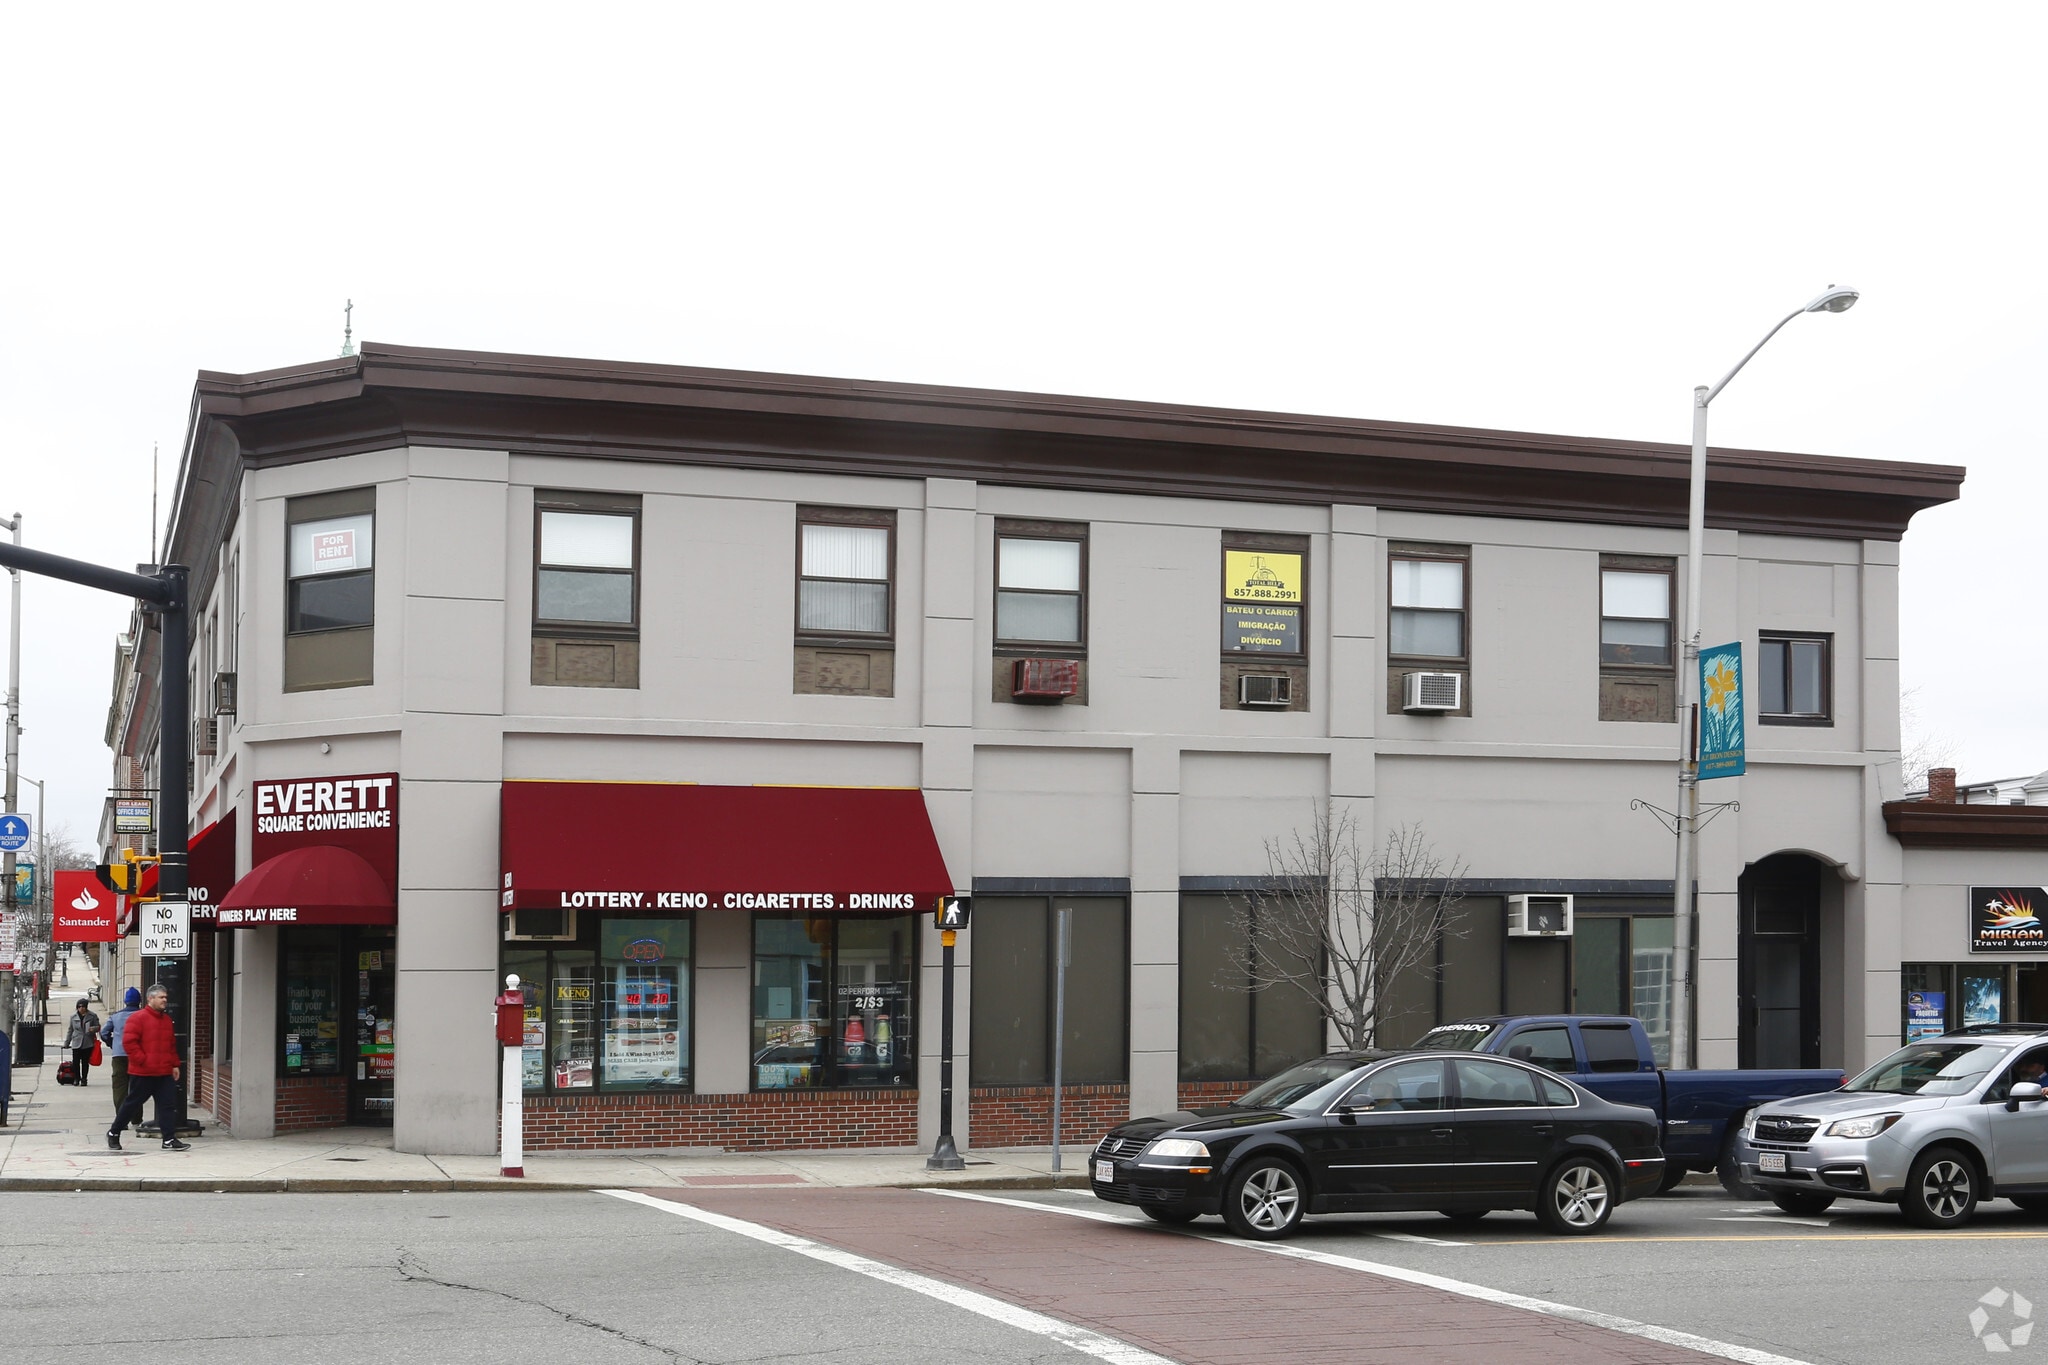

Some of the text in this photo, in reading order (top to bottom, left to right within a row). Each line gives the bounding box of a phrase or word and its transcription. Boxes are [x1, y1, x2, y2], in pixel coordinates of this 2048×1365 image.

[322, 535, 344, 546] FOR
[318, 545, 348, 559] RENT
[1233, 588, 1297, 599] 857.888.2991
[1226, 606, 1298, 617] BATEU O CARRO?
[1238, 621, 1286, 632] IMIGRAÇÃO
[257, 778, 392, 814] EVERETT
[134, 808, 149, 816] SPACE
[258, 810, 391, 834] SQUARE CONVENIENCE
[561, 891, 915, 909] LOTTERY KENO CIGARETTES DRINKS
[156, 908, 173, 919] NO
[245, 908, 267, 922] PLAY
[269, 907, 297, 921] HERE
[58, 916, 111, 927] Santander
[152, 923, 178, 934] TURN
[1980, 929, 2044, 940] MIRIAM
[144, 938, 184, 949] ON RED
[2012, 939, 2048, 948] Agency
[623, 943, 666, 960] OPEN
[287, 986, 326, 999] Thank you
[557, 986, 590, 998] KENO
[848, 987, 881, 995] PERFORM
[626, 993, 641, 1005] 40
[652, 993, 668, 1005] 20
[855, 996, 884, 1009] 2/$3
[291, 999, 323, 1013] for your
[289, 1012, 322, 1024] business
[847, 1046, 862, 1056] G2
[760, 1064, 785, 1073] 100%
